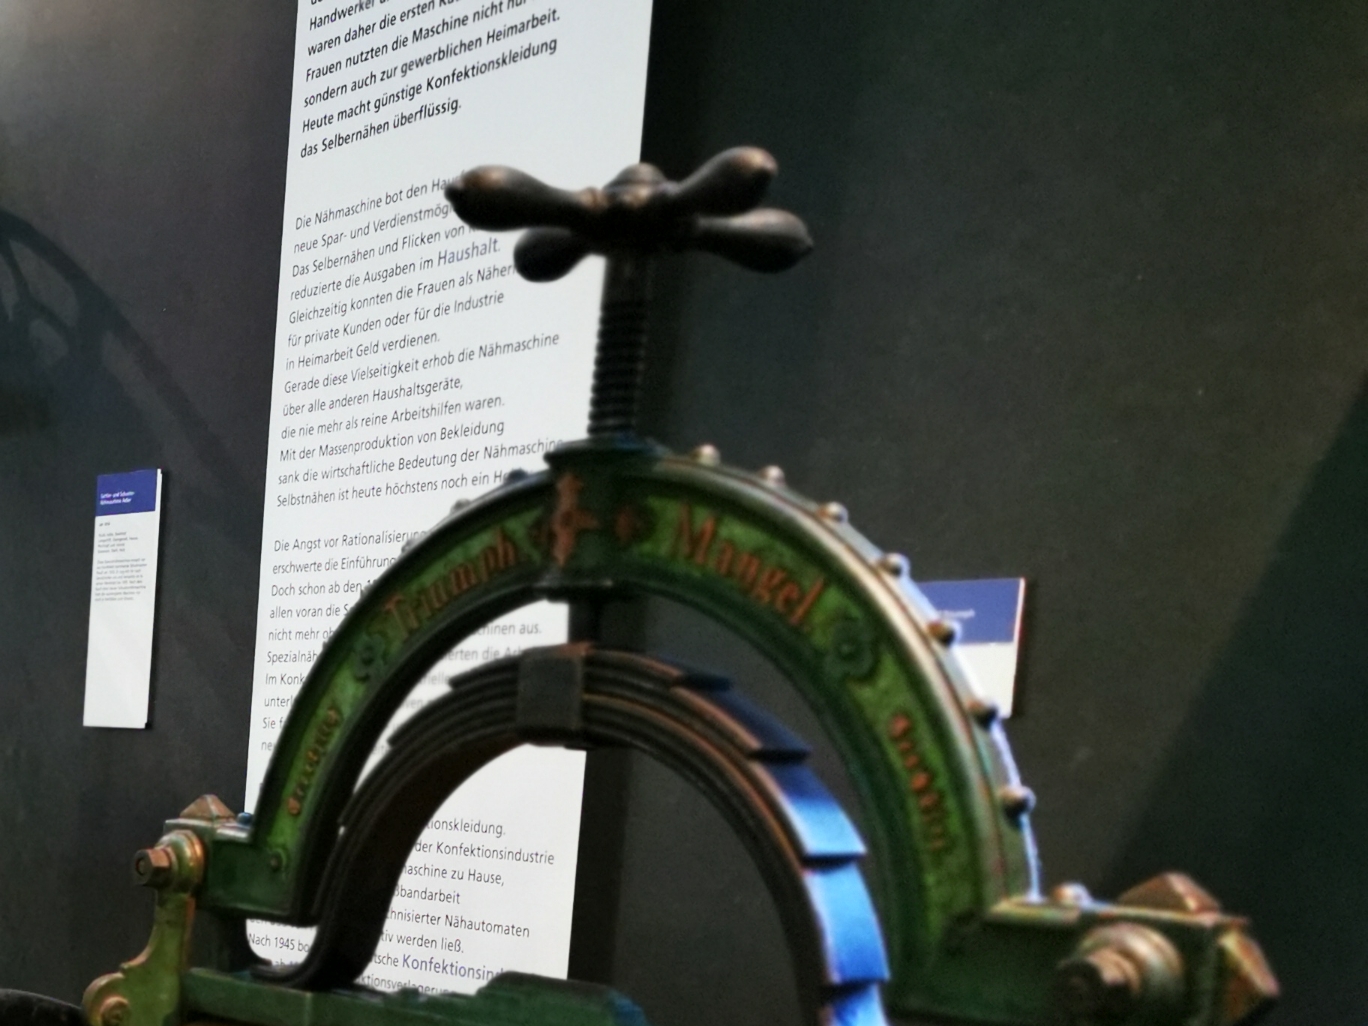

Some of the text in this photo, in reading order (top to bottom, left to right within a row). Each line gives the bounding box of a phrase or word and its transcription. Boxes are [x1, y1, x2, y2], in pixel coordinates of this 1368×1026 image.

[306, 61, 342, 82] Frauen
[345, 43, 388, 69] nutzten
[392, 35, 409, 51] die
[412, 15, 469, 44] Maschine
[472, 1, 503, 23] nicht
[307, 0, 435, 56] waren daher die ersten
[303, 8, 560, 108] sondern auch zur gewerblichen Heimarbeit.
[302, 38, 558, 133] Heute macht günstige Konfektionskleidung
[300, 97, 461, 158] das Selbernähen überflüssig.
[296, 214, 312, 230] Die
[314, 197, 382, 225] Nähmaschine
[385, 188, 403, 205] bot
[406, 182, 428, 200] den
[292, 264, 310, 278] Das
[312, 248, 375, 273] Selbernähen
[378, 238, 398, 256] und
[402, 229, 441, 250] Flicken
[444, 224, 465, 240] von
[294, 238, 318, 254] neue
[321, 232, 347, 249] Spar-
[350, 222, 370, 239] und
[290, 237, 501, 301] reduzierte die Ausgaben im Haushalt.
[289, 301, 347, 324] Gleichzeitig
[350, 292, 393, 311] konnten
[396, 286, 413, 301] die
[417, 276, 455, 297] Frauen
[458, 271, 473, 287] als
[288, 290, 504, 347] für private Kunden oder für die Industrie
[284, 332, 560, 394] Gerade diese Vielseitigkeit erhob die Nähmaschine
[285, 332, 440, 371] in Heimarbeit Geld verdienen.
[283, 377, 463, 417] über alle anderen Haushaltsgeräte,
[281, 396, 505, 440] die nie mehr als reine Arbeitshilfen waren.
[279, 421, 505, 462] Mit der Massenproduktion von Bekleidung
[278, 470, 300, 485] sank
[302, 468, 318, 482] die
[321, 458, 395, 480] wirtschaftliche
[398, 453, 457, 471] Bedeutung
[460, 448, 479, 462] der
[277, 491, 335, 507] Selbstnähen
[338, 488, 349, 501] ist
[352, 485, 382, 499] heute
[385, 476, 437, 496] höchstens
[440, 473, 469, 491] noch
[471, 471, 492, 487] ein
[274, 538, 290, 552] Die
[292, 537, 321, 553] Angst
[323, 537, 339, 548] vor
[272, 560, 323, 574] erschwerte
[324, 558, 338, 571] die
[271, 584, 296, 597] Doch
[298, 582, 326, 595] schon
[328, 581, 340, 593] ab
[343, 580, 362, 593] den
[269, 606, 293, 619] allen
[295, 606, 323, 618] voran
[326, 604, 341, 617] die
[268, 628, 292, 641] nicht
[294, 627, 320, 641] mehr
[519, 622, 542, 635] aus.
[483, 646, 500, 661] die
[265, 673, 277, 685] Im
[262, 717, 276, 729] Sie
[436, 841, 555, 865] Konfektionsindustrie
[451, 868, 464, 880] zu
[467, 868, 505, 886] Hause,
[249, 933, 271, 947] Nach
[274, 936, 295, 951] 1945
[396, 934, 437, 949] werden
[441, 937, 464, 954] ließ.
[444, 914, 530, 938] Nähautomaten
